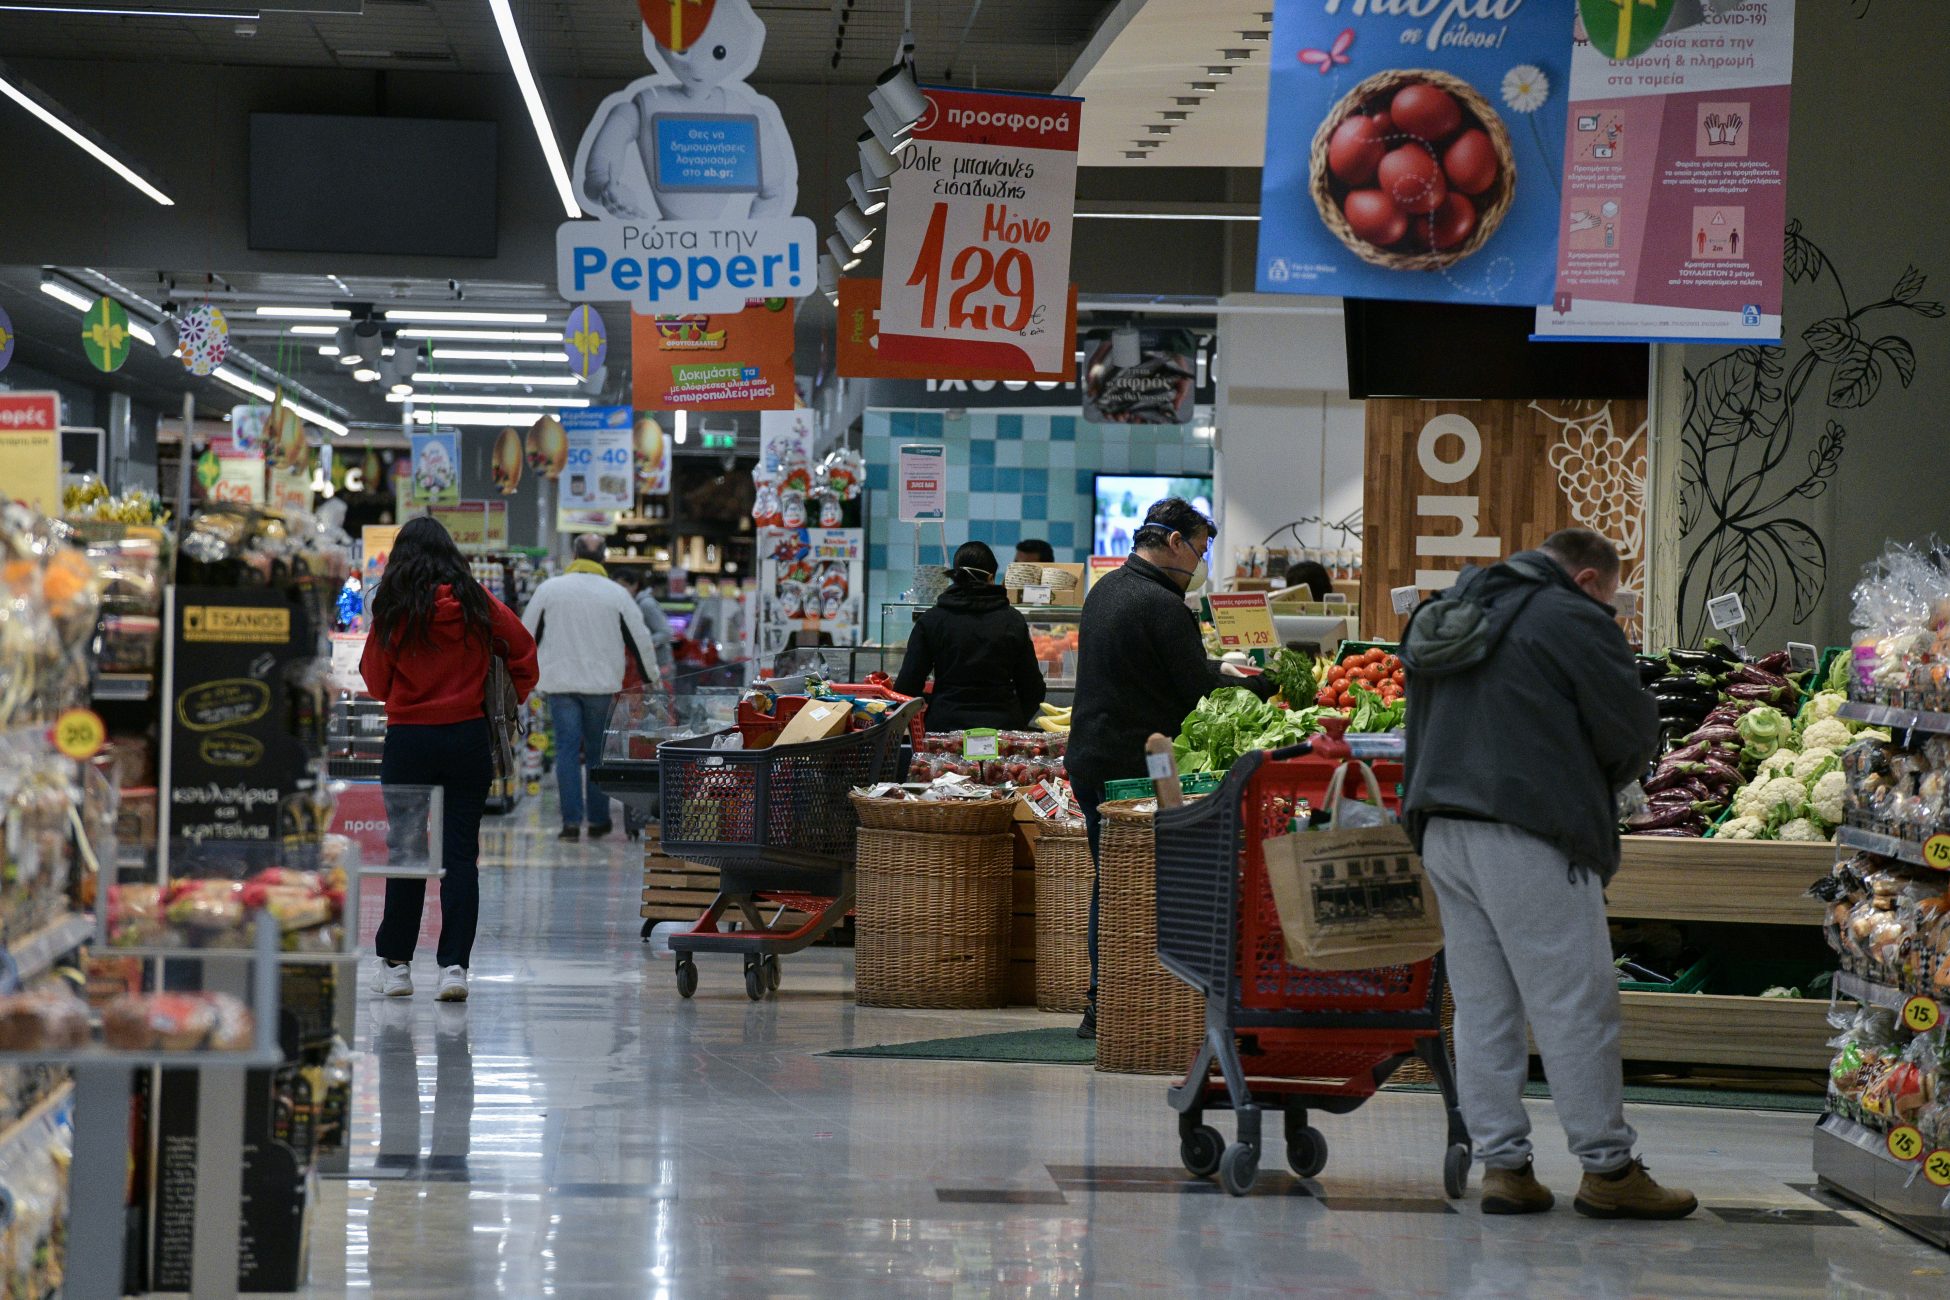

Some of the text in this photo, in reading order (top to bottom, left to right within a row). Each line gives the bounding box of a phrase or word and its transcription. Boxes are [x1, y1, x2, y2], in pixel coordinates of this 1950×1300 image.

[1691, 37, 1725, 48] κατά
[1730, 38, 1754, 50] την
[1675, 56, 1686, 67] &
[1690, 54, 1754, 68] πληρωμή
[1607, 73, 1684, 87] στα ταμεία
[948, 108, 1070, 135] προσφορά
[712, 131, 725, 139] να
[902, 144, 942, 172] Dole
[682, 169, 701, 177] στο
[623, 226, 759, 253] Ρώτα την
[573, 242, 801, 301] Pepper!
[679, 367, 756, 383] Δοκιμάστε τα
[673, 387, 749, 404] οπωροπωλείο
[750, 384, 775, 401] μας!
[0, 405, 47, 428] ορές
